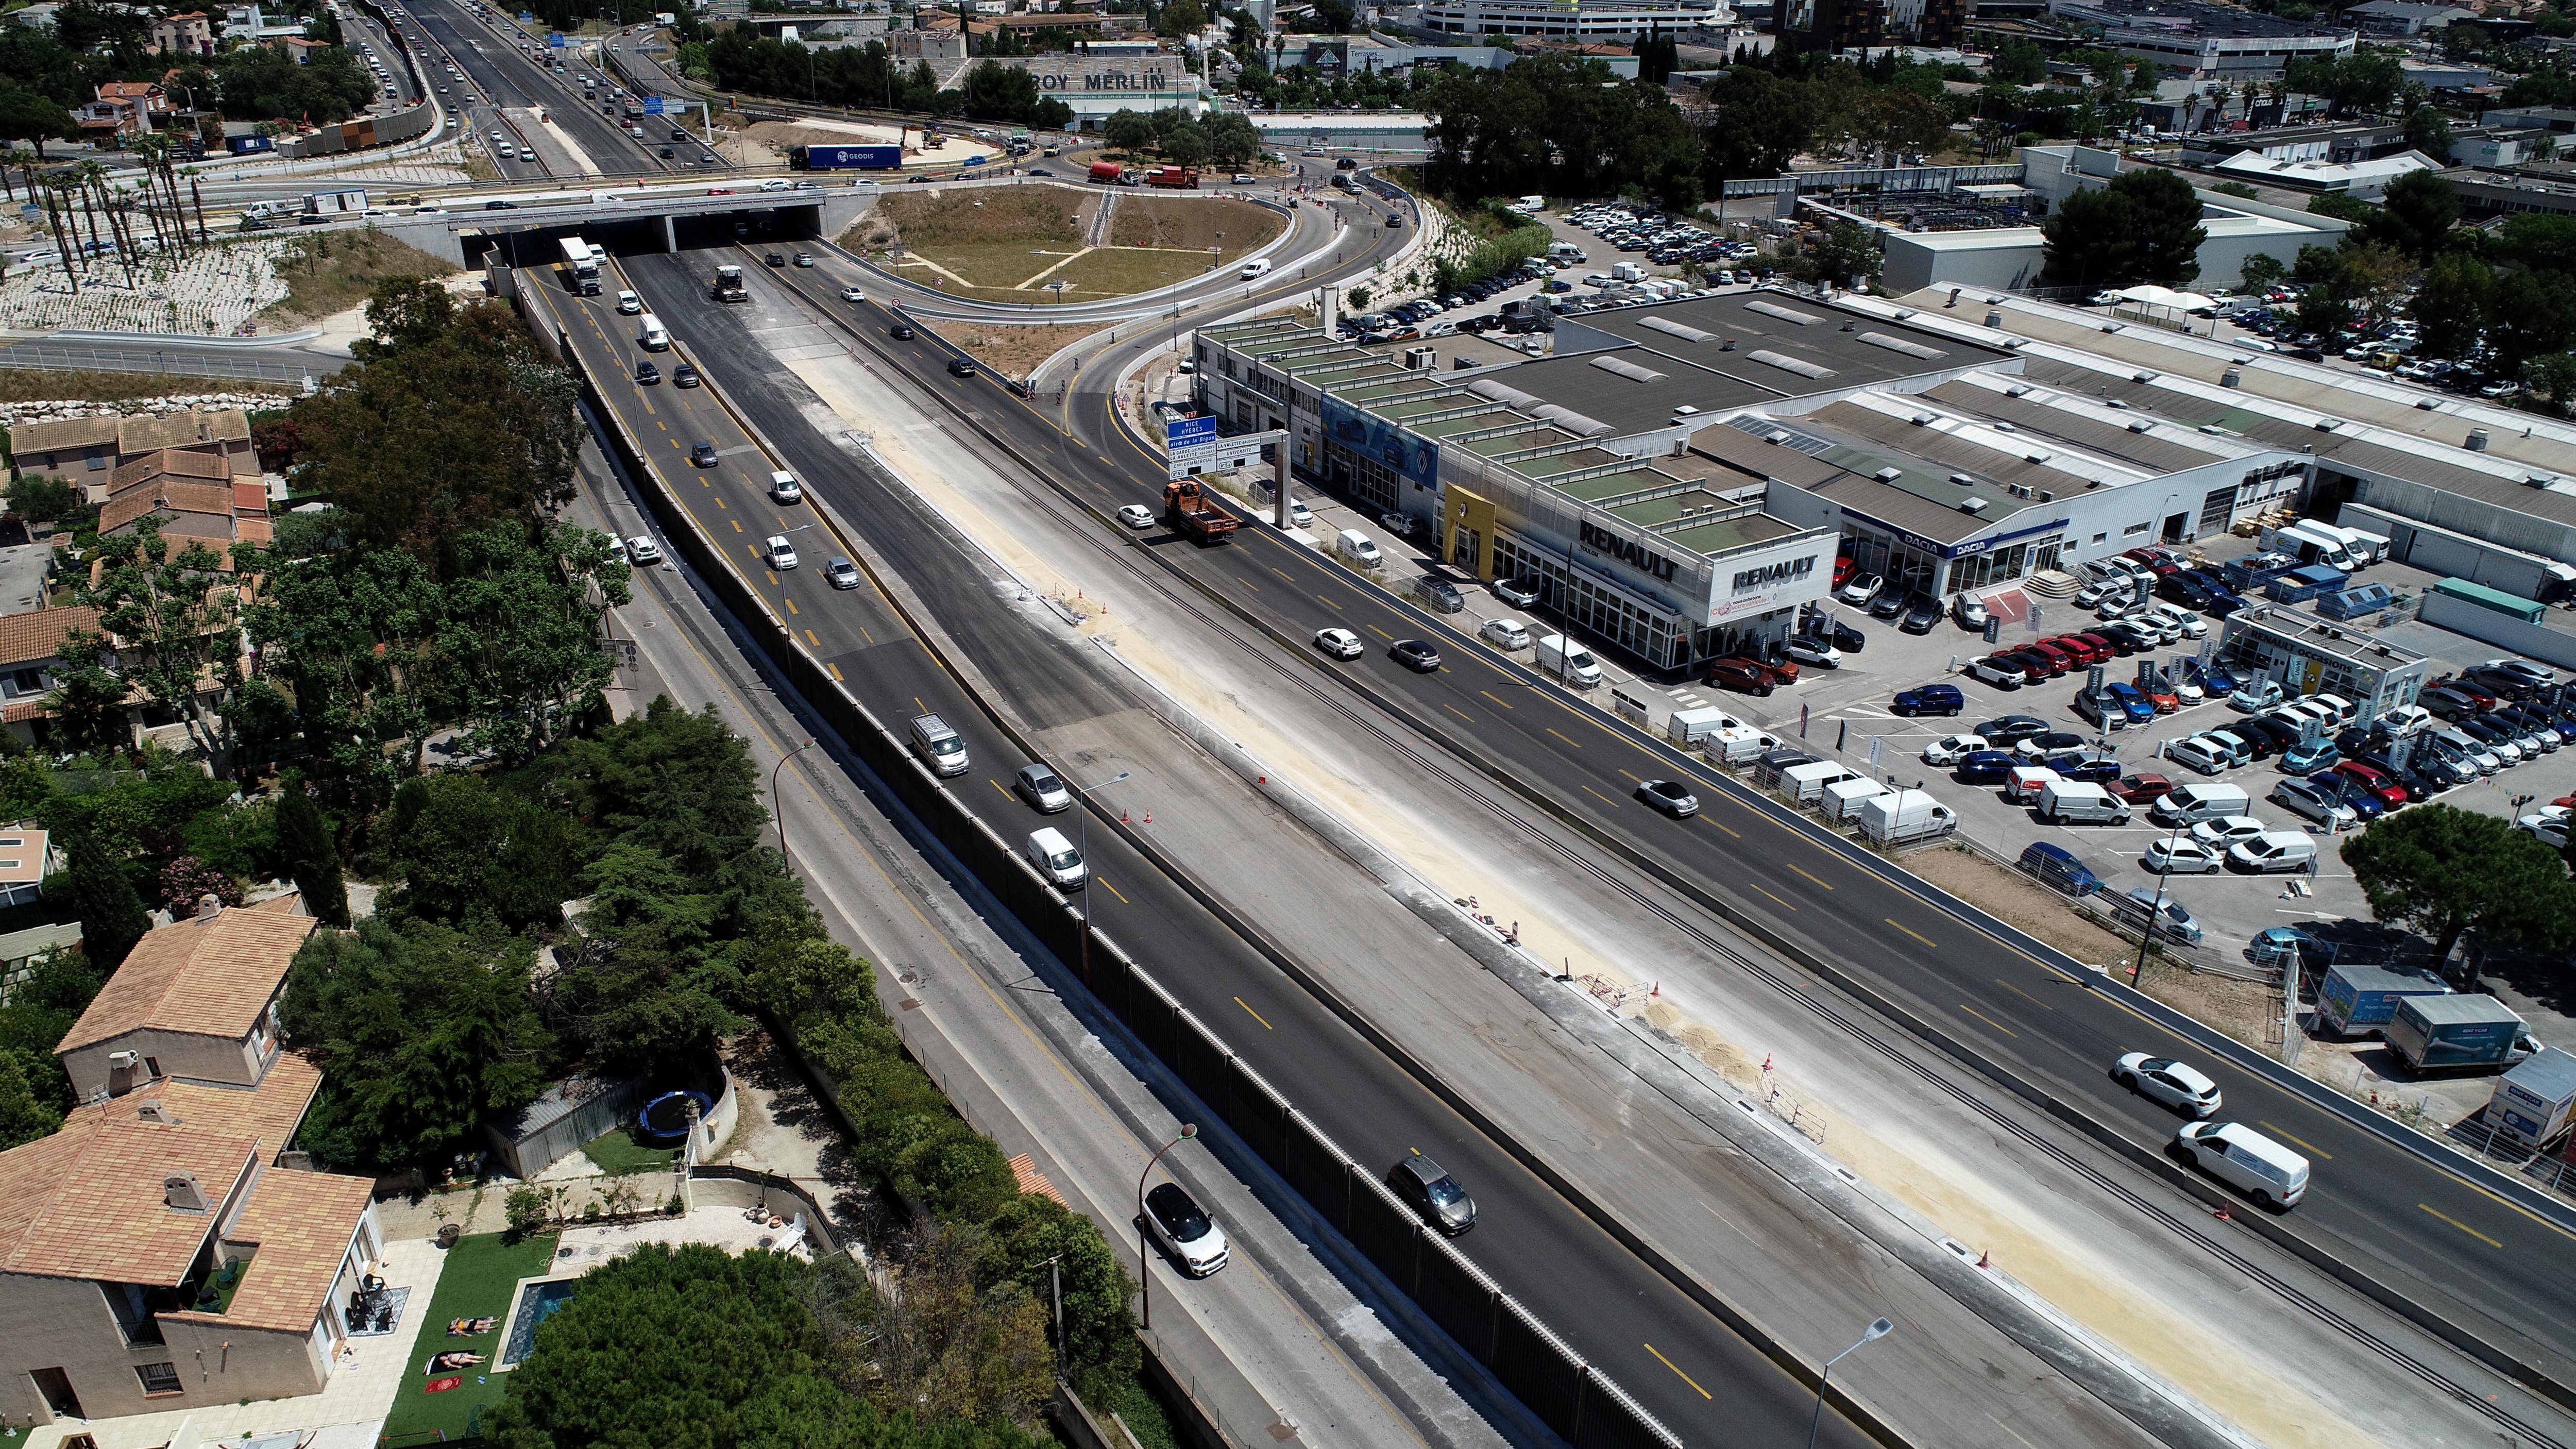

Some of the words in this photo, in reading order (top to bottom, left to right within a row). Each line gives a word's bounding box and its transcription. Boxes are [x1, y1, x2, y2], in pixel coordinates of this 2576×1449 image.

[1031, 75, 1067, 90] ROY
[1084, 75, 1165, 90] MERLIN
[1234, 385, 1256, 402] RENAULT
[1257, 398, 1277, 413] minute
[1181, 426, 1203, 435] HYÈRES
[1183, 457, 1212, 467] COMMERCIAL
[1579, 544, 1598, 558] TOULON
[1580, 519, 1679, 583] RENAULT
[1905, 534, 1938, 554] DACIA
[1956, 541, 1985, 555] DACIA
[1733, 554, 1818, 589] RENAULT
[2250, 630, 2295, 652] RENAULT
[2298, 648, 2352, 673] occasions
